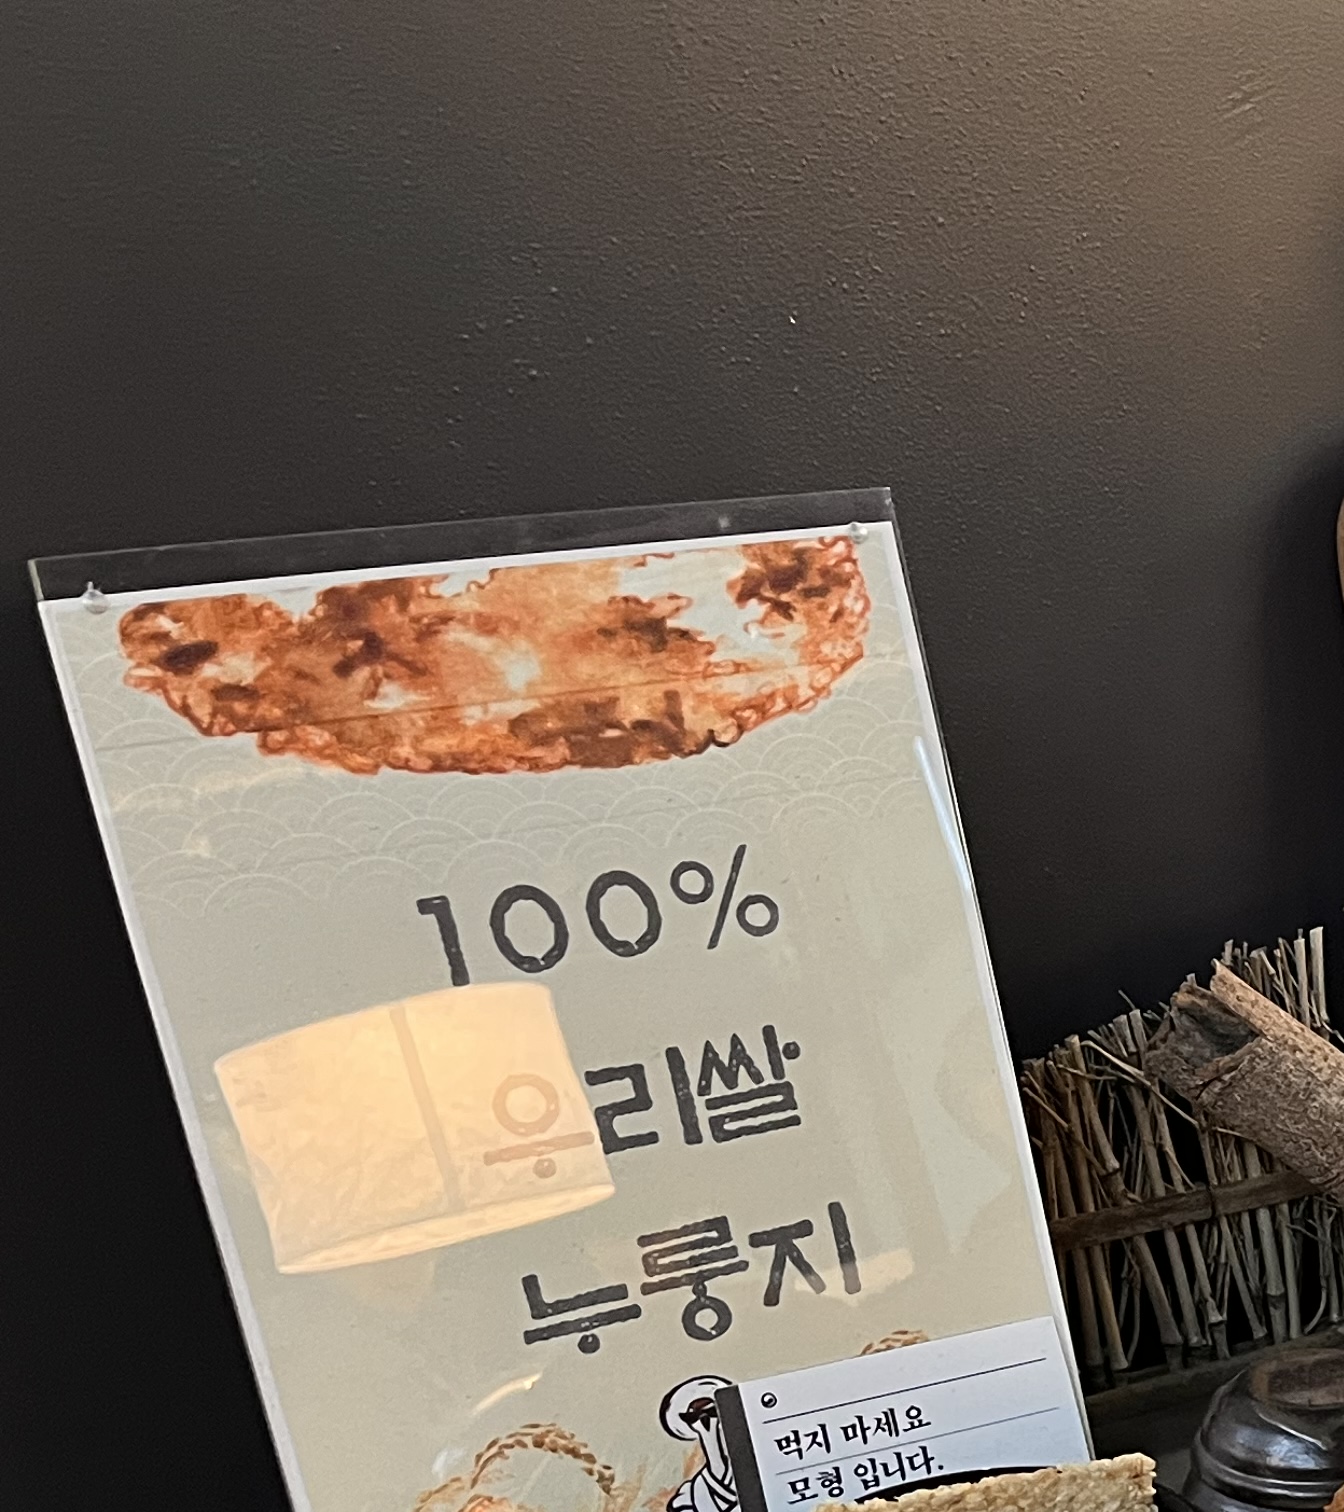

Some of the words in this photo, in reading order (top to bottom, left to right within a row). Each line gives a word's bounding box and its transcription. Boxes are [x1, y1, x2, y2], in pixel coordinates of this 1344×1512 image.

[417, 844, 780, 987] 100%
[483, 1024, 801, 1179] 우리쌀
[521, 1201, 862, 1354] 누룽지
[774, 1423, 831, 1460] 먹지
[840, 1405, 932, 1446] 마세요
[787, 1466, 844, 1504] 모형
[854, 1446, 944, 1491] 입니다.
